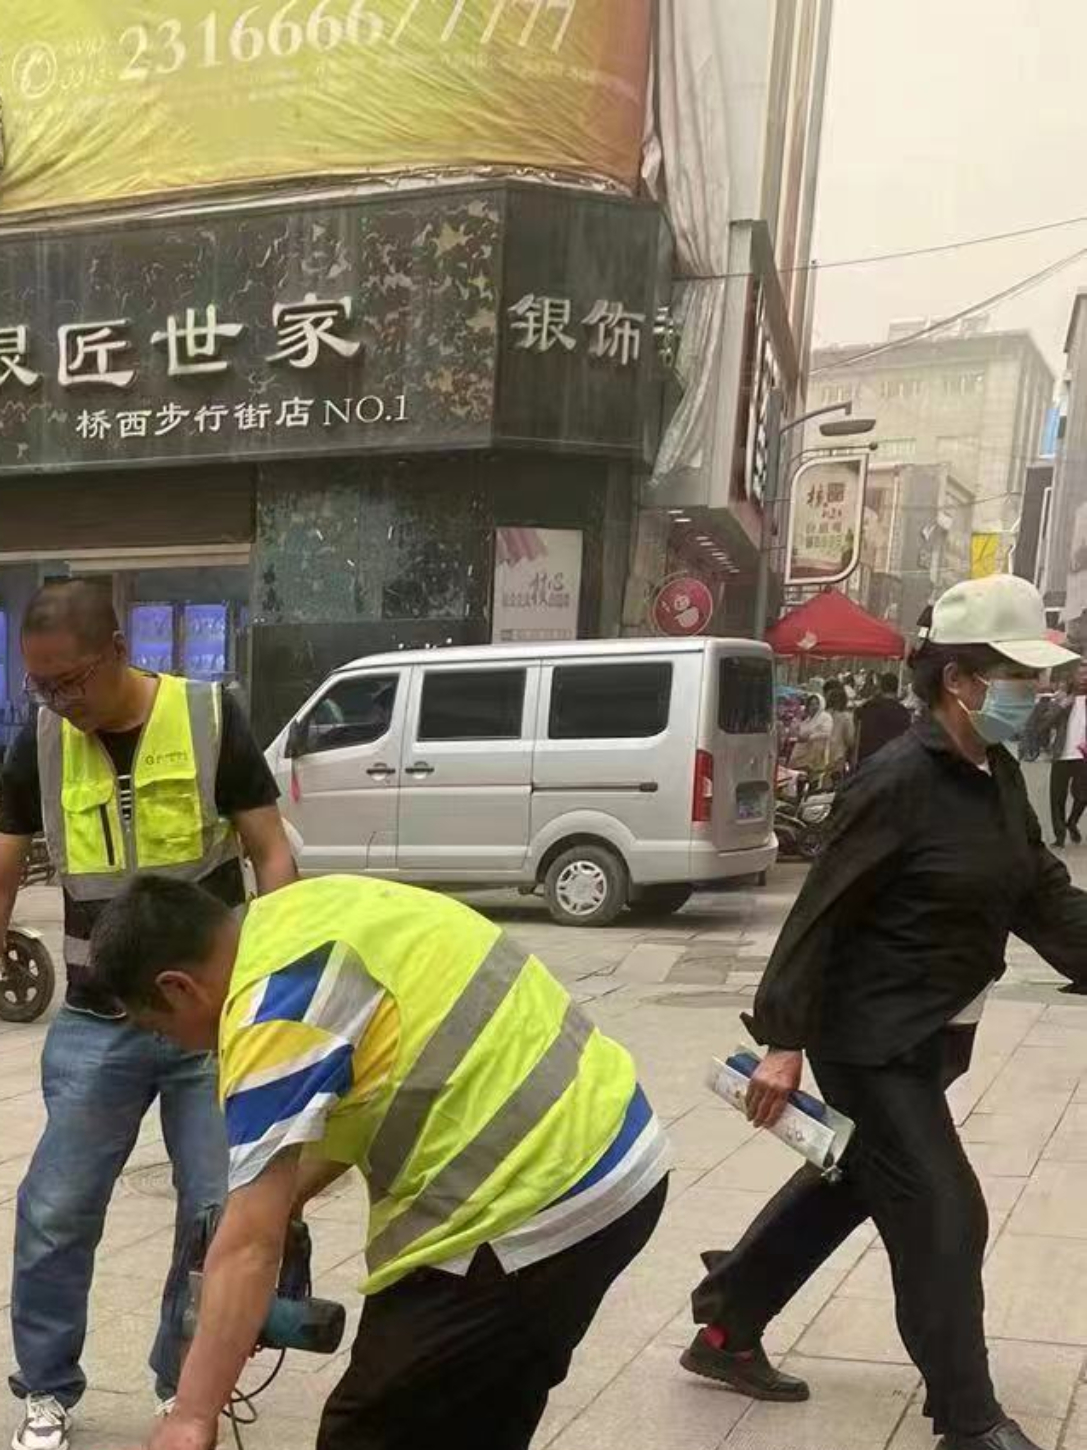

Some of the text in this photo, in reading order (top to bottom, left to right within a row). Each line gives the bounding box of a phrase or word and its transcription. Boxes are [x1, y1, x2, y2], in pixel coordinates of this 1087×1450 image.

[75, 395, 410, 440] 桥西步行街店 NO.1
